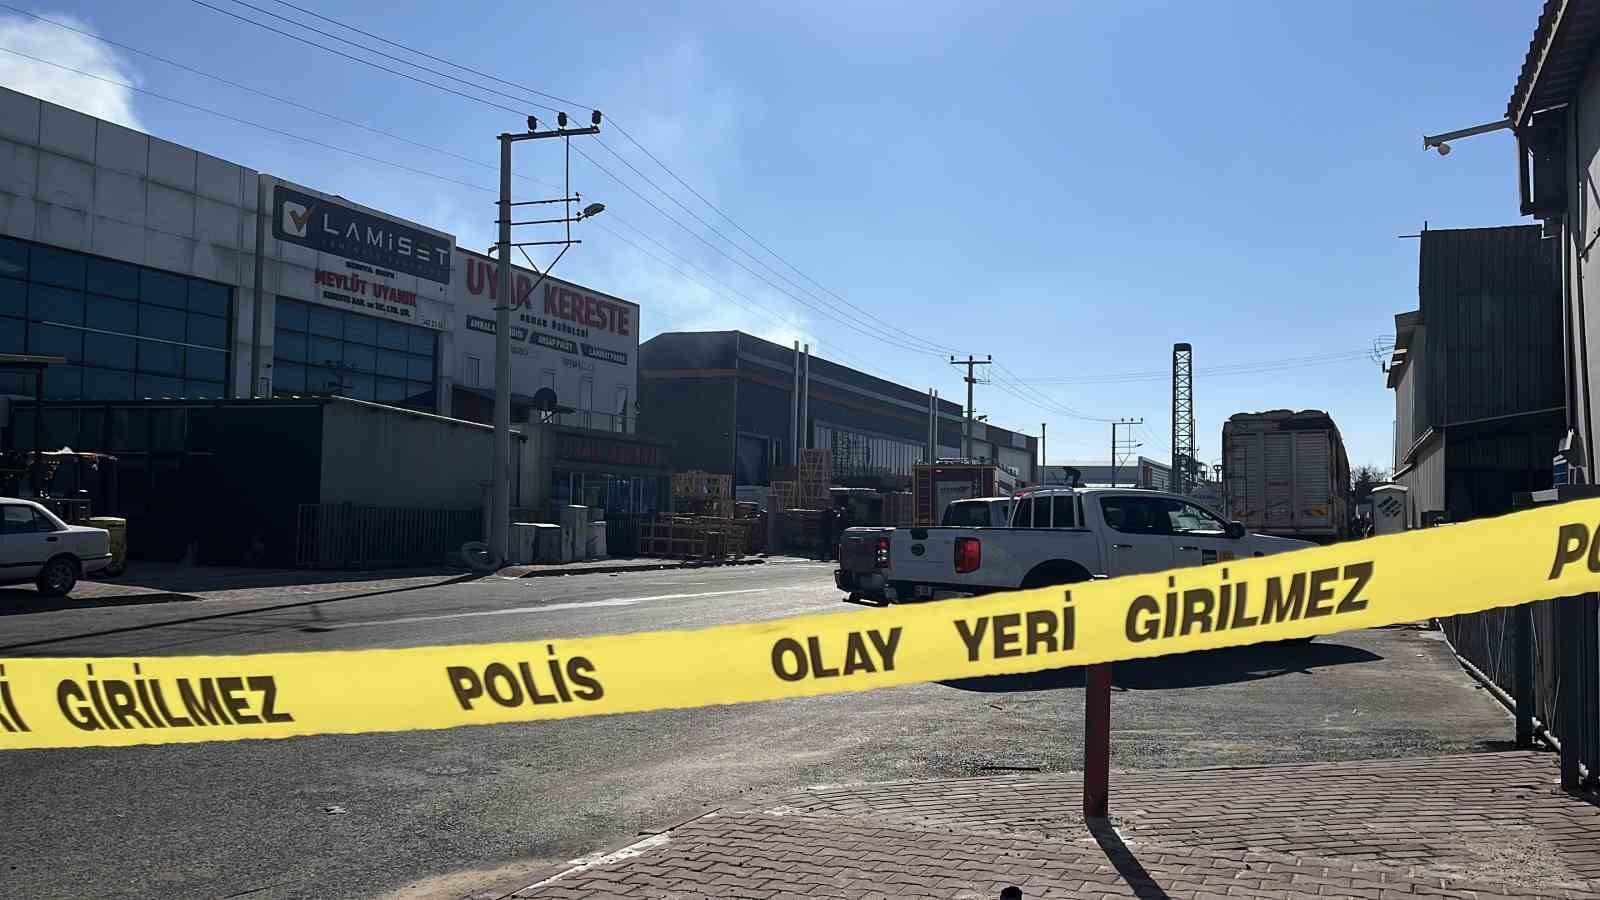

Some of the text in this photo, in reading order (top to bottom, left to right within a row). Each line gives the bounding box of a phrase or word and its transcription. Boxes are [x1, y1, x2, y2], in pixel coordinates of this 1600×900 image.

[314, 268, 369, 295] MEVLÜT
[544, 283, 630, 337] KERESTE
[57, 663, 294, 732] GİRİLMEZ
[446, 645, 603, 711] POLİS
[772, 617, 903, 682] OLAY
[954, 590, 1075, 661] YERİ
[1126, 561, 1374, 642] GİRİLMEZ
